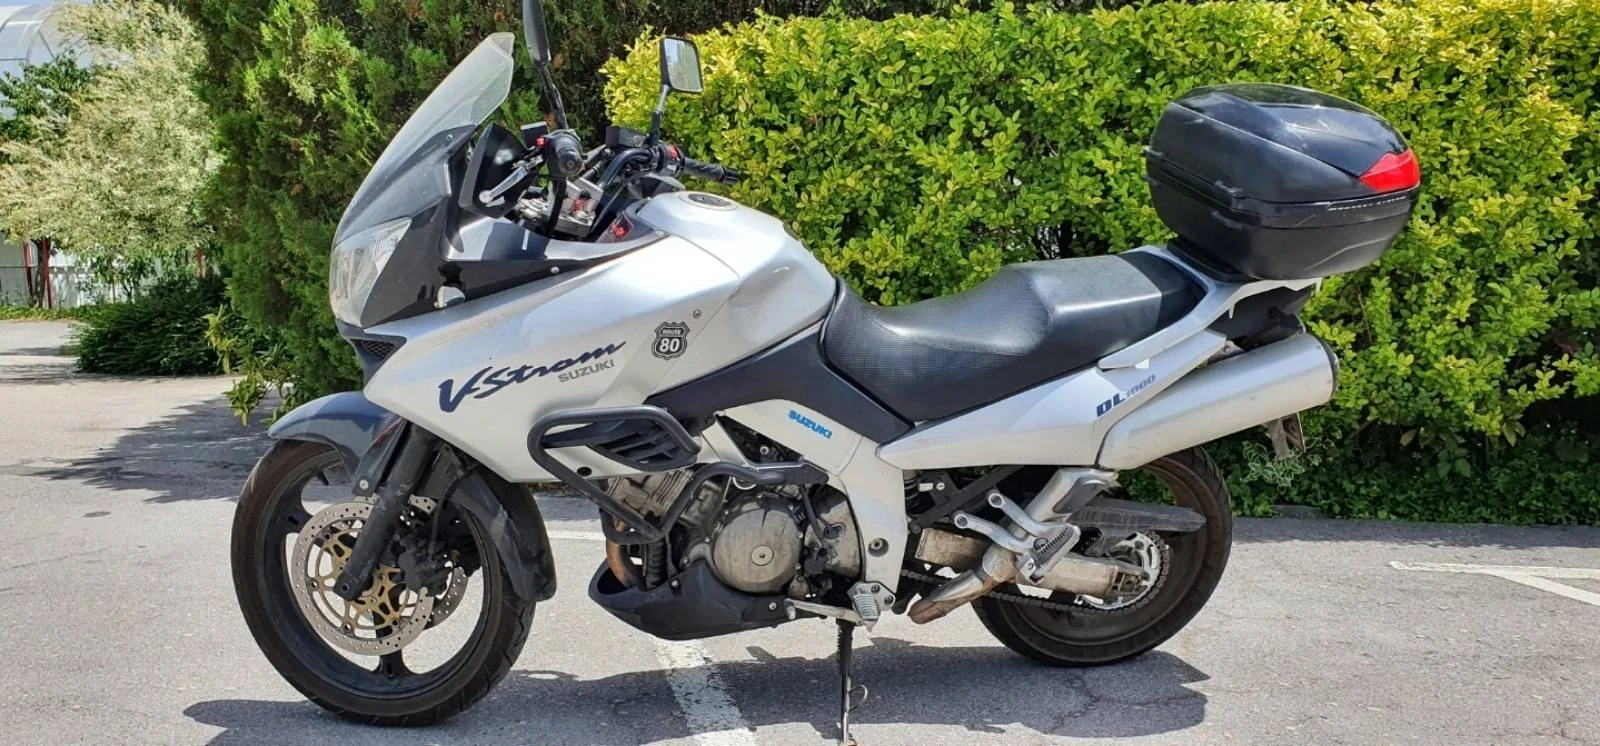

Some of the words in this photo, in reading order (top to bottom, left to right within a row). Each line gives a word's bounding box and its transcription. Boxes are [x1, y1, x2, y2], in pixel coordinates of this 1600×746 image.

[659, 337, 681, 353] 80
[558, 359, 616, 384] SUZUKI
[788, 409, 833, 440] SUZUKI
